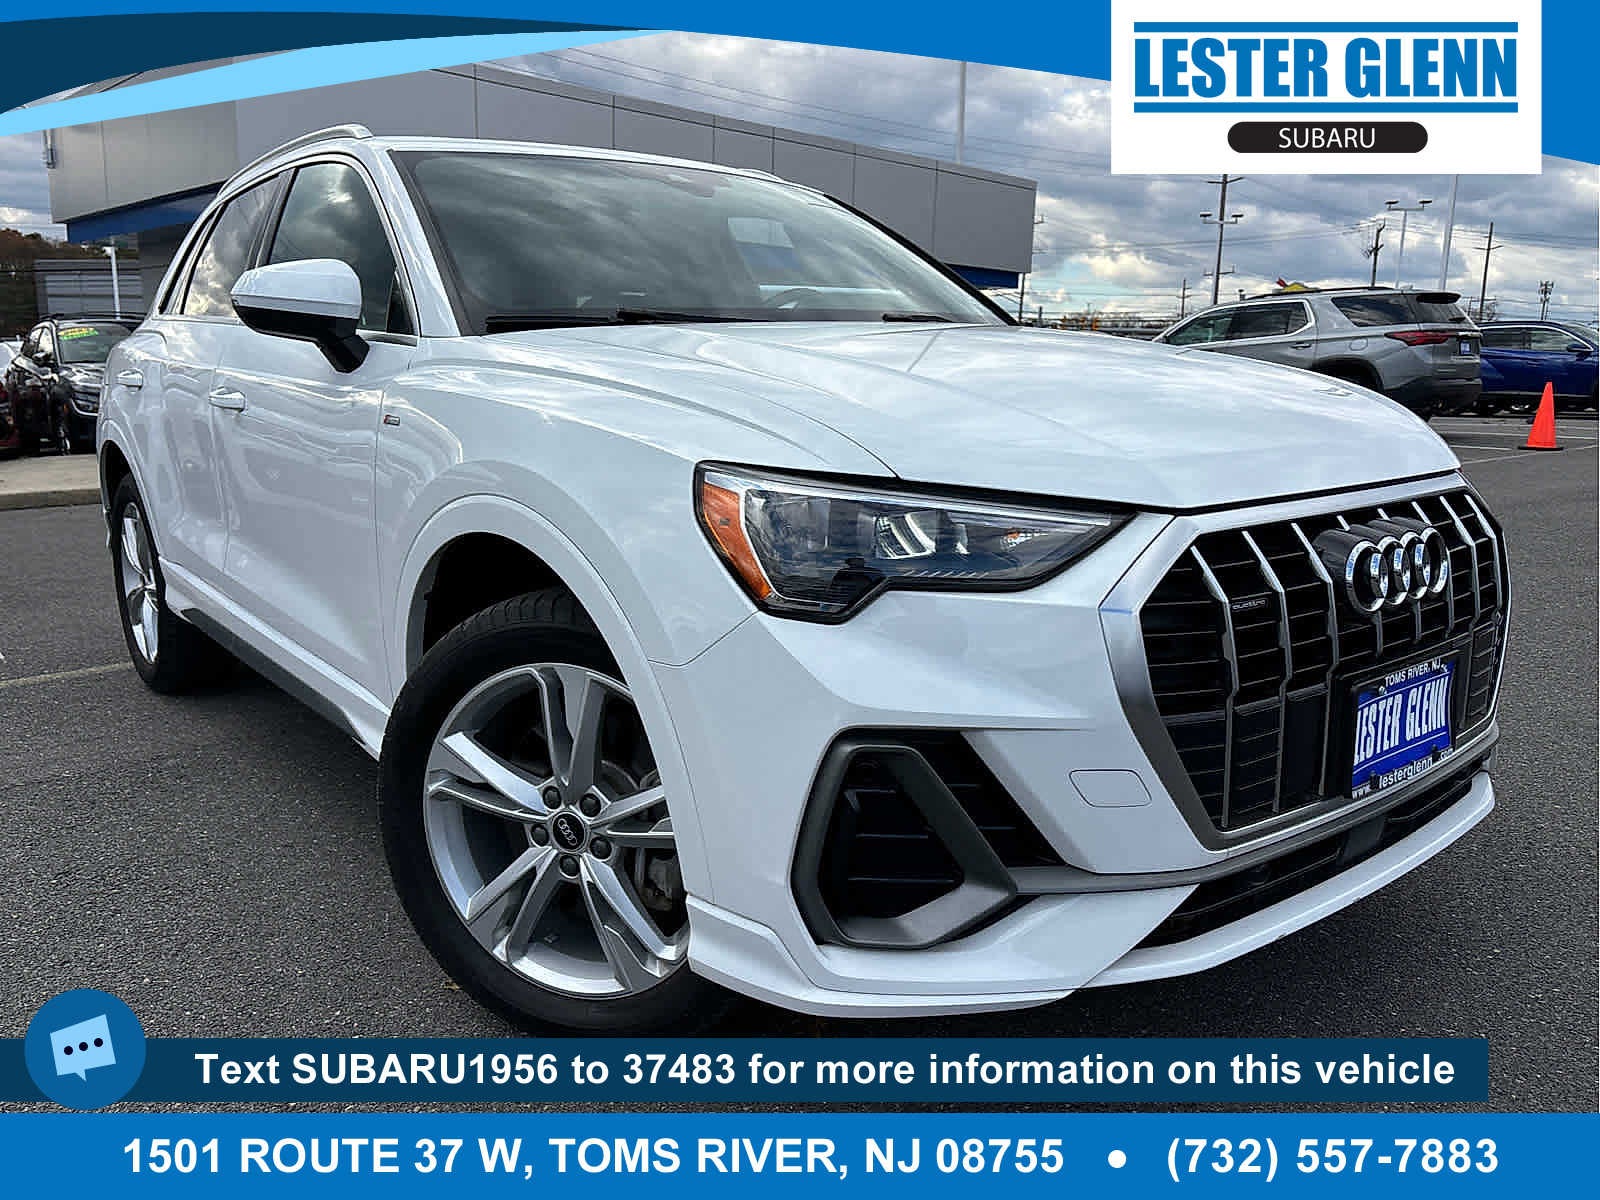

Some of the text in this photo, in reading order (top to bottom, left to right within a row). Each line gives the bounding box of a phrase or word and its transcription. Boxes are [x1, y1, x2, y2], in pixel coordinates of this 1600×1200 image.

[1385, 670, 1406, 687] TOMS
[1408, 662, 1431, 680] RIVER,
[1353, 675, 1449, 766] LESTER GLENN
